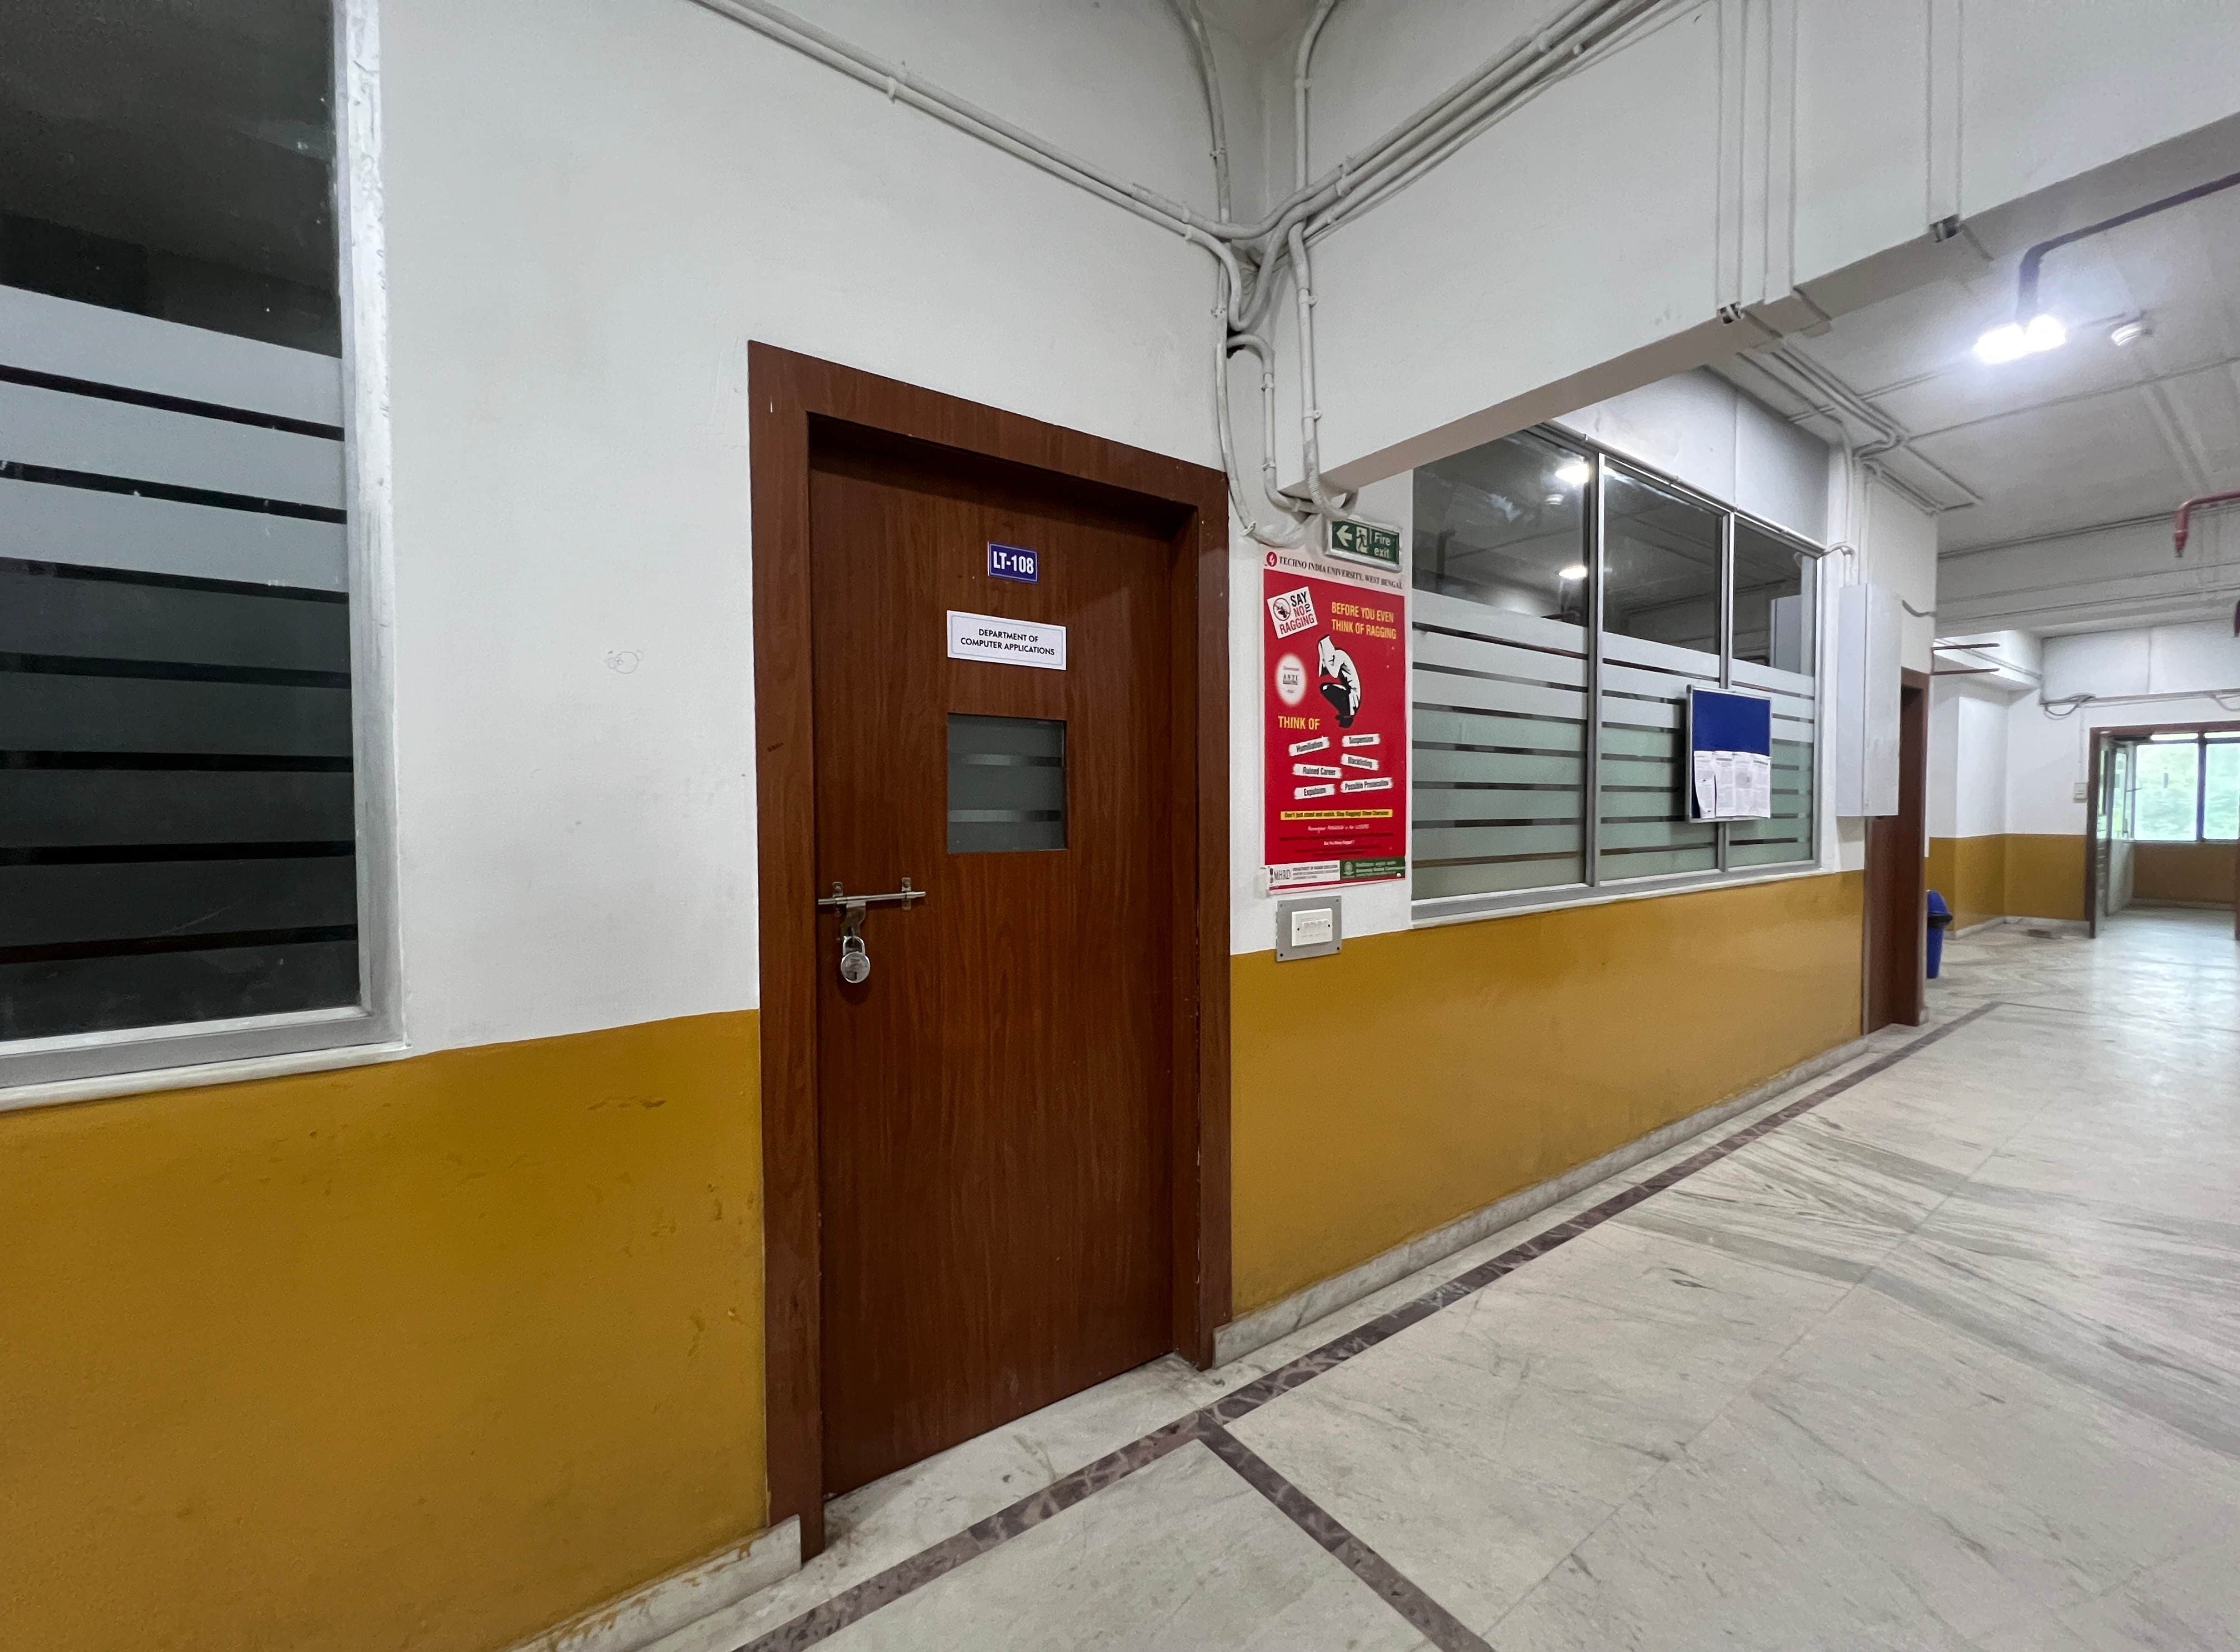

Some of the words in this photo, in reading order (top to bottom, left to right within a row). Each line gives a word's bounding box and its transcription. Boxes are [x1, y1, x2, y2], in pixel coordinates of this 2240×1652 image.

[1374, 532, 1391, 546] Fire
[1374, 547, 1389, 559] exit
[993, 550, 1034, 574] LT-108
[1279, 556, 1307, 569] TECHNO
[1308, 560, 1326, 573] INDIA
[1365, 574, 1380, 584] WEST
[1381, 578, 1403, 589] BENGAL
[1290, 591, 1307, 607] SAY
[1293, 605, 1305, 618] NO
[1332, 602, 1359, 617] BEFORE
[1361, 607, 1375, 620] YOU
[1376, 610, 1394, 623] EVEN
[1279, 613, 1314, 635] RAGGING
[1331, 619, 1354, 633] THINK
[1355, 622, 1365, 634] OF
[1366, 624, 1397, 640] RAGGING
[978, 628, 1027, 642] DEPARTMENT
[961, 637, 1002, 649] COMPUTER
[1004, 643, 1055, 655] APPLICATIONS
[1278, 715, 1306, 729] THINK
[1308, 718, 1321, 730] OF
